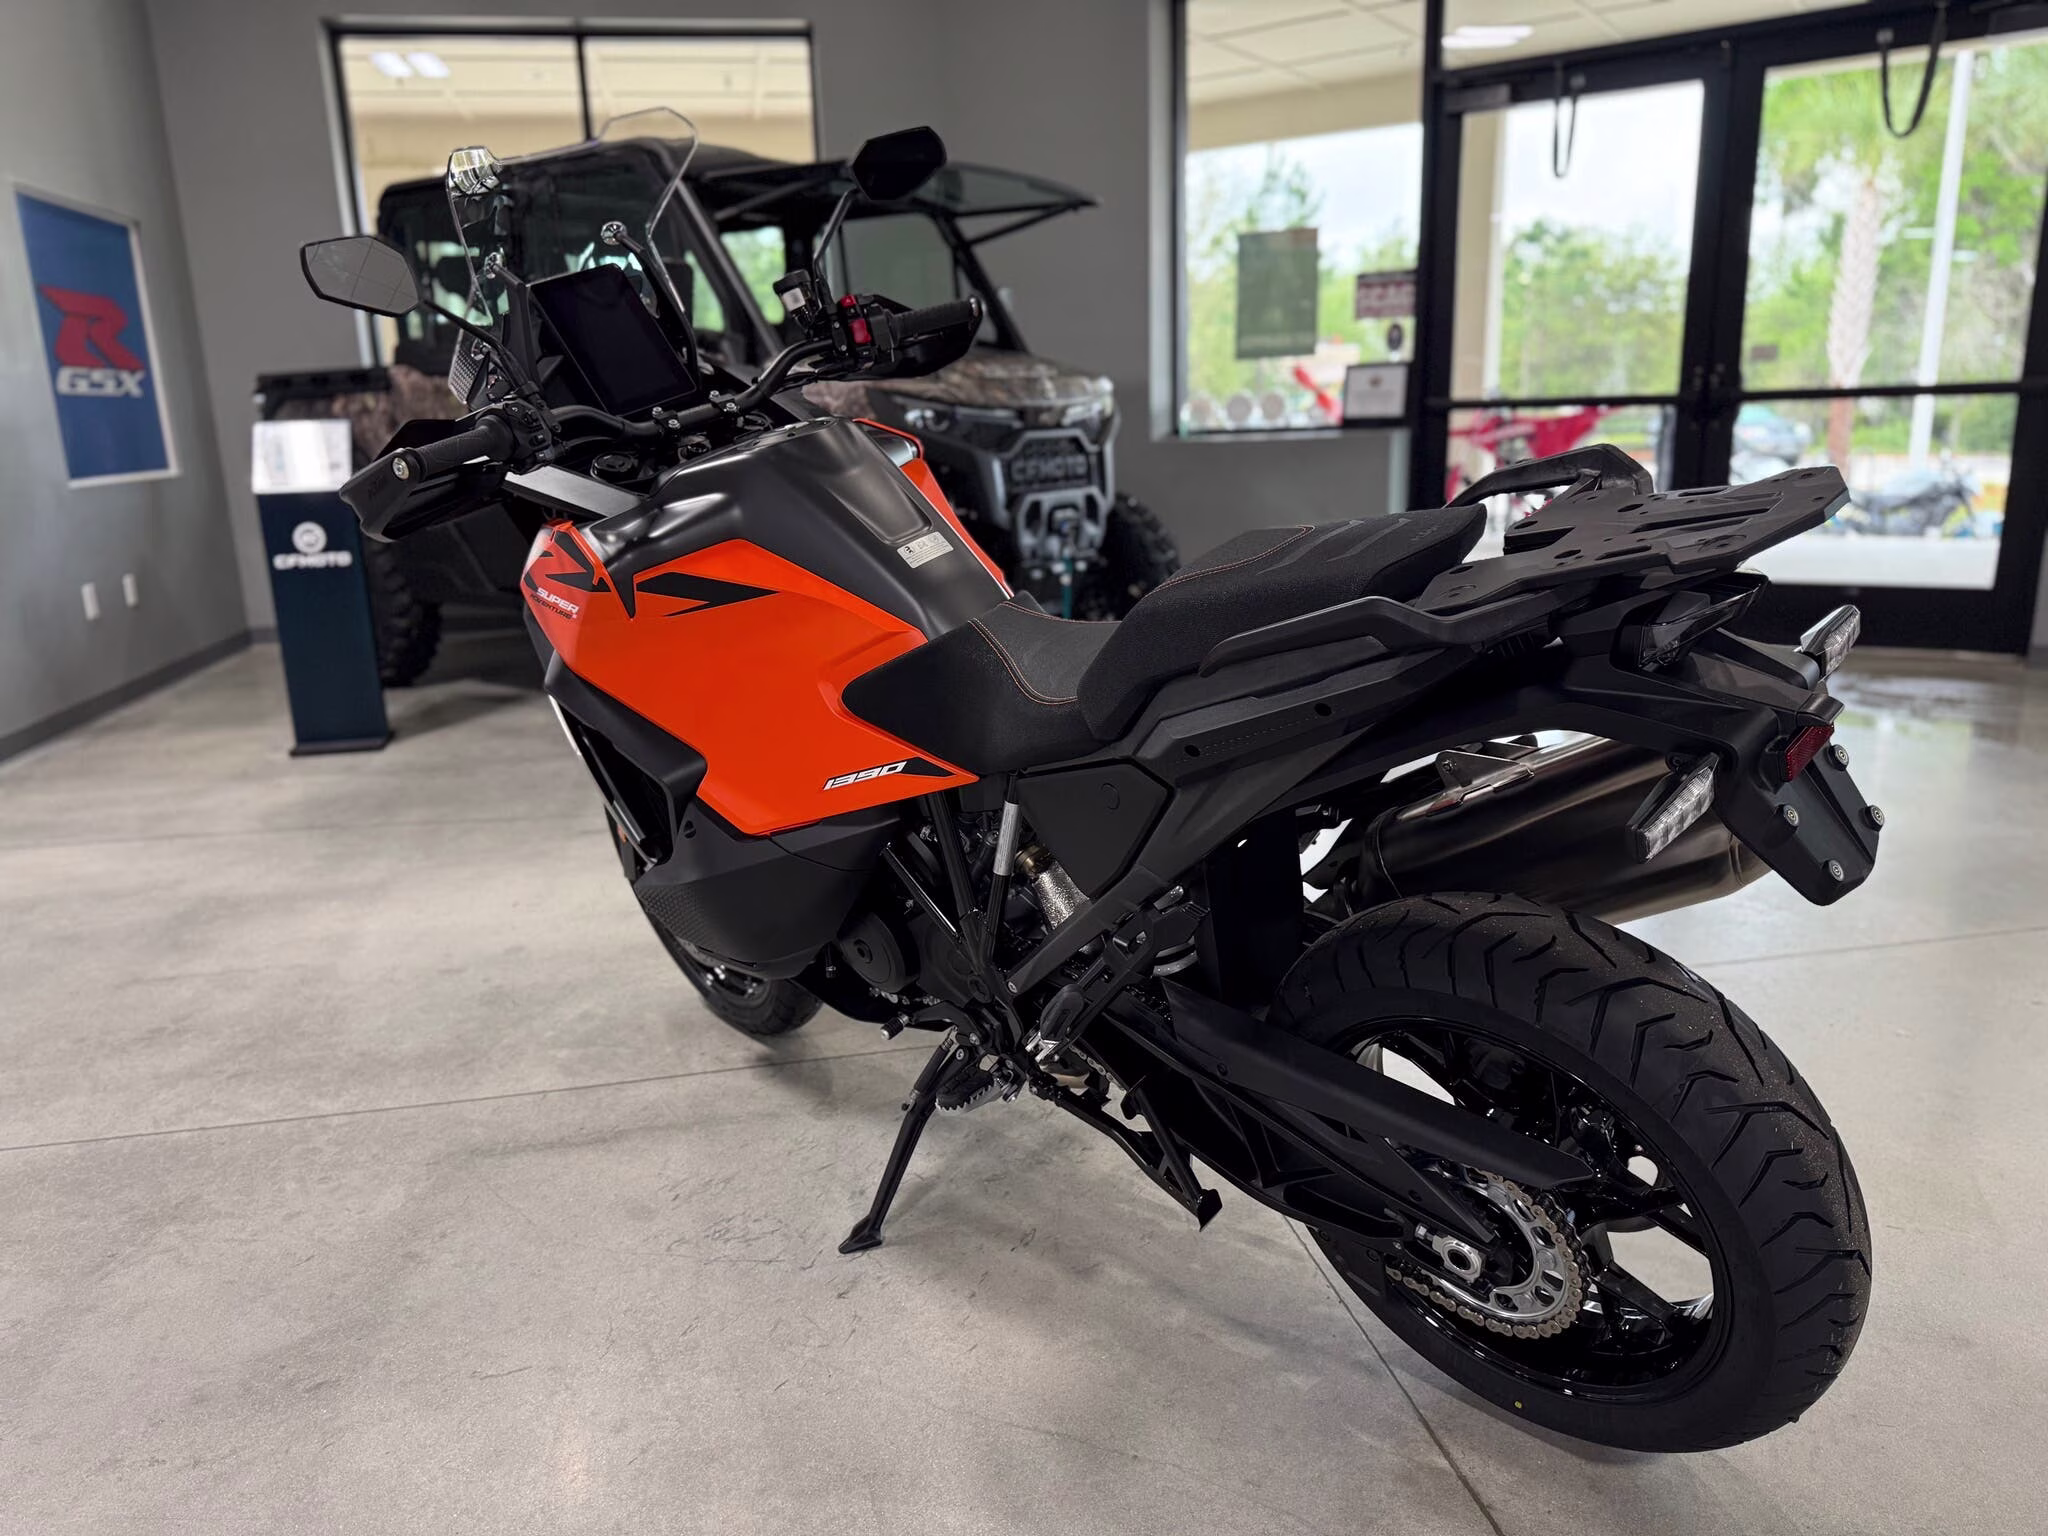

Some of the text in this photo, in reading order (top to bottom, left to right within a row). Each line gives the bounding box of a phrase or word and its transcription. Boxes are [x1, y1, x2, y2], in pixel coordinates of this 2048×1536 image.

[57, 366, 144, 398] GSX
[536, 587, 579, 613] SUPER
[823, 761, 907, 790] 1390
